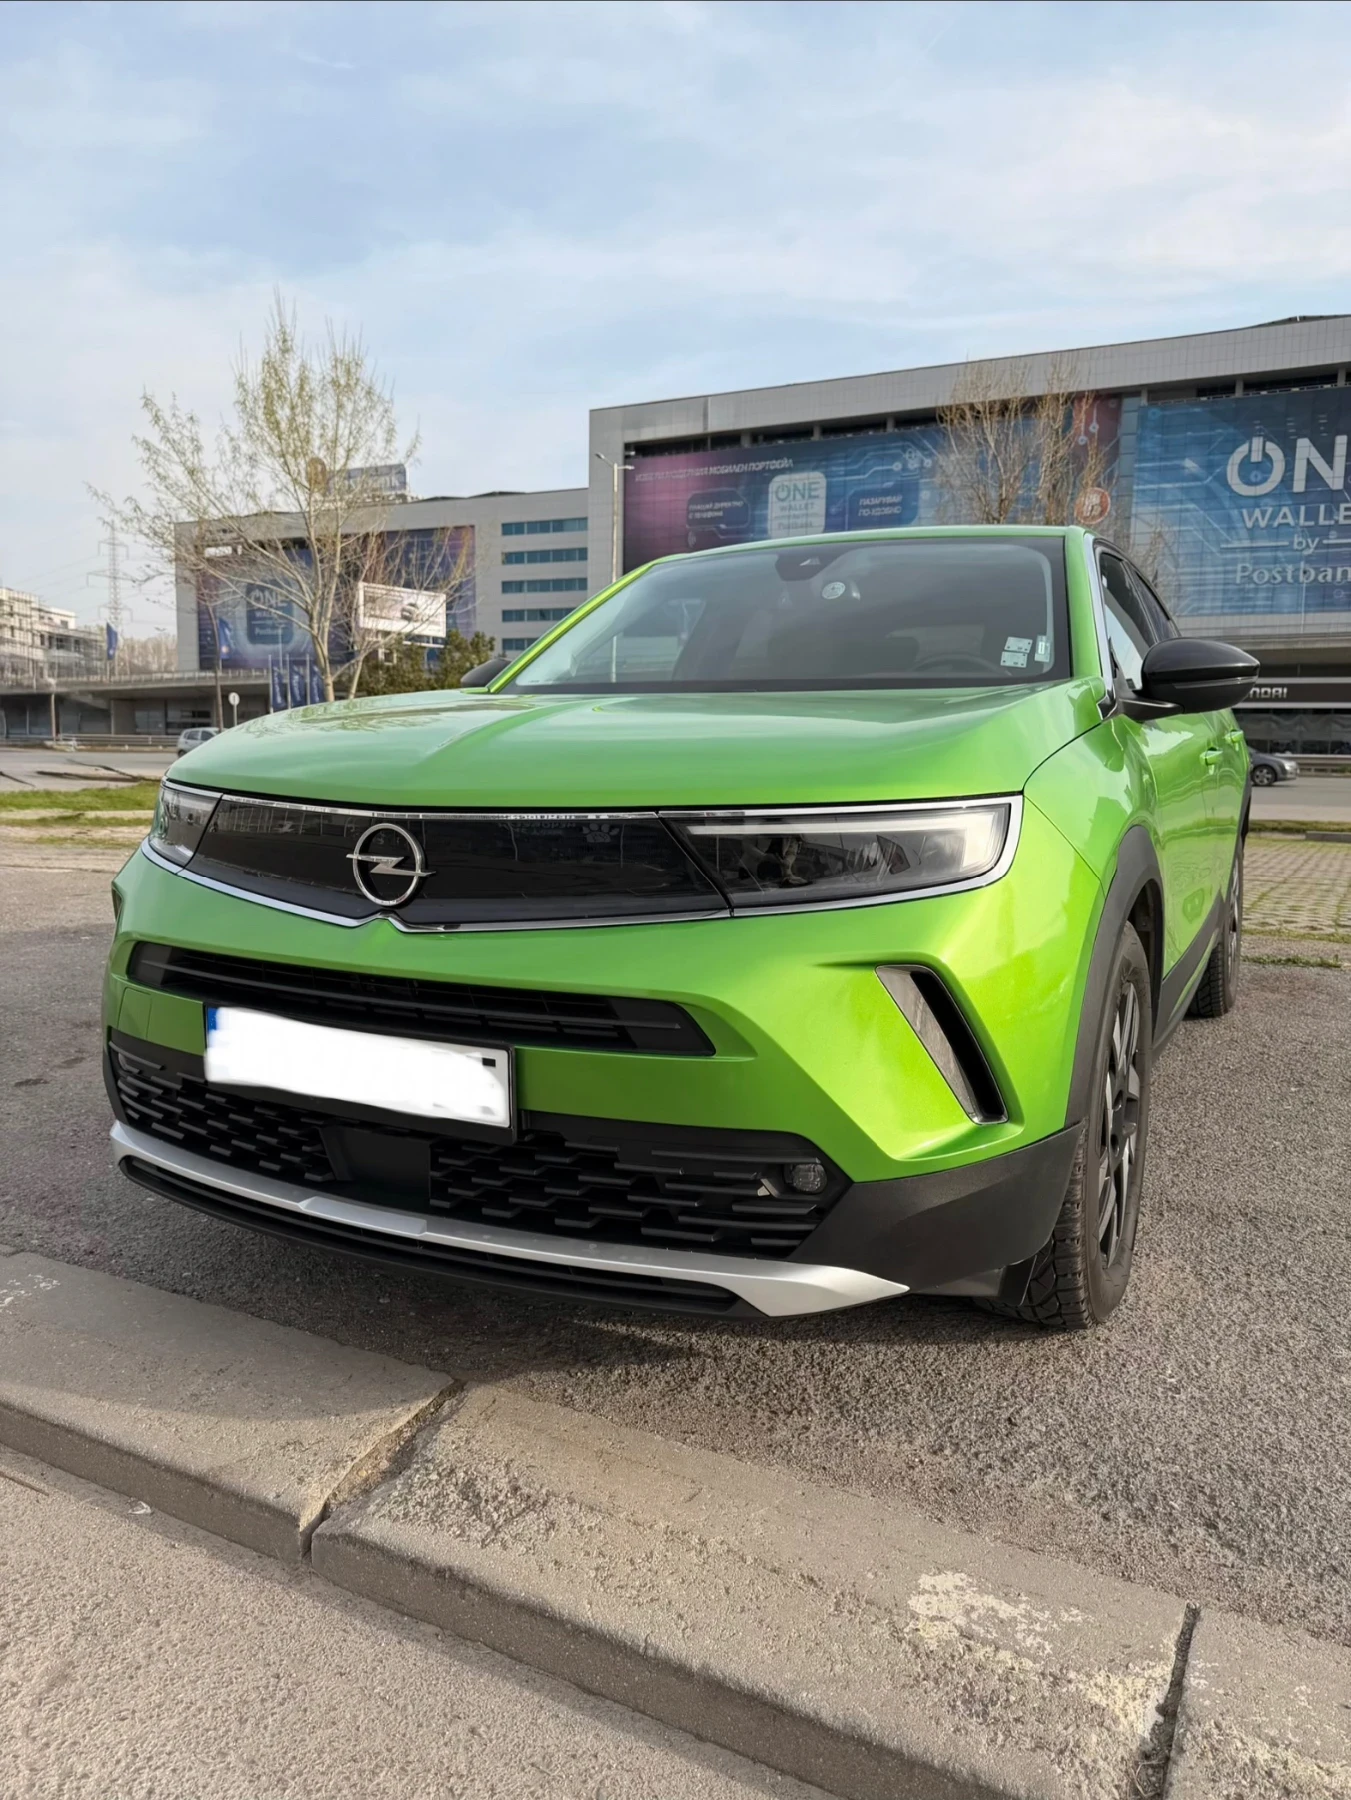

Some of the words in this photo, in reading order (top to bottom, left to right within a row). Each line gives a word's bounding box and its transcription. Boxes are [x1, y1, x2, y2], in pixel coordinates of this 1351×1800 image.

[1227, 436, 1347, 496] ON
[775, 481, 820, 502] ONE
[779, 502, 814, 512] WALLET
[1242, 503, 1351, 529] WALLE
[1293, 534, 1319, 555] by
[1236, 561, 1351, 584] Postban
